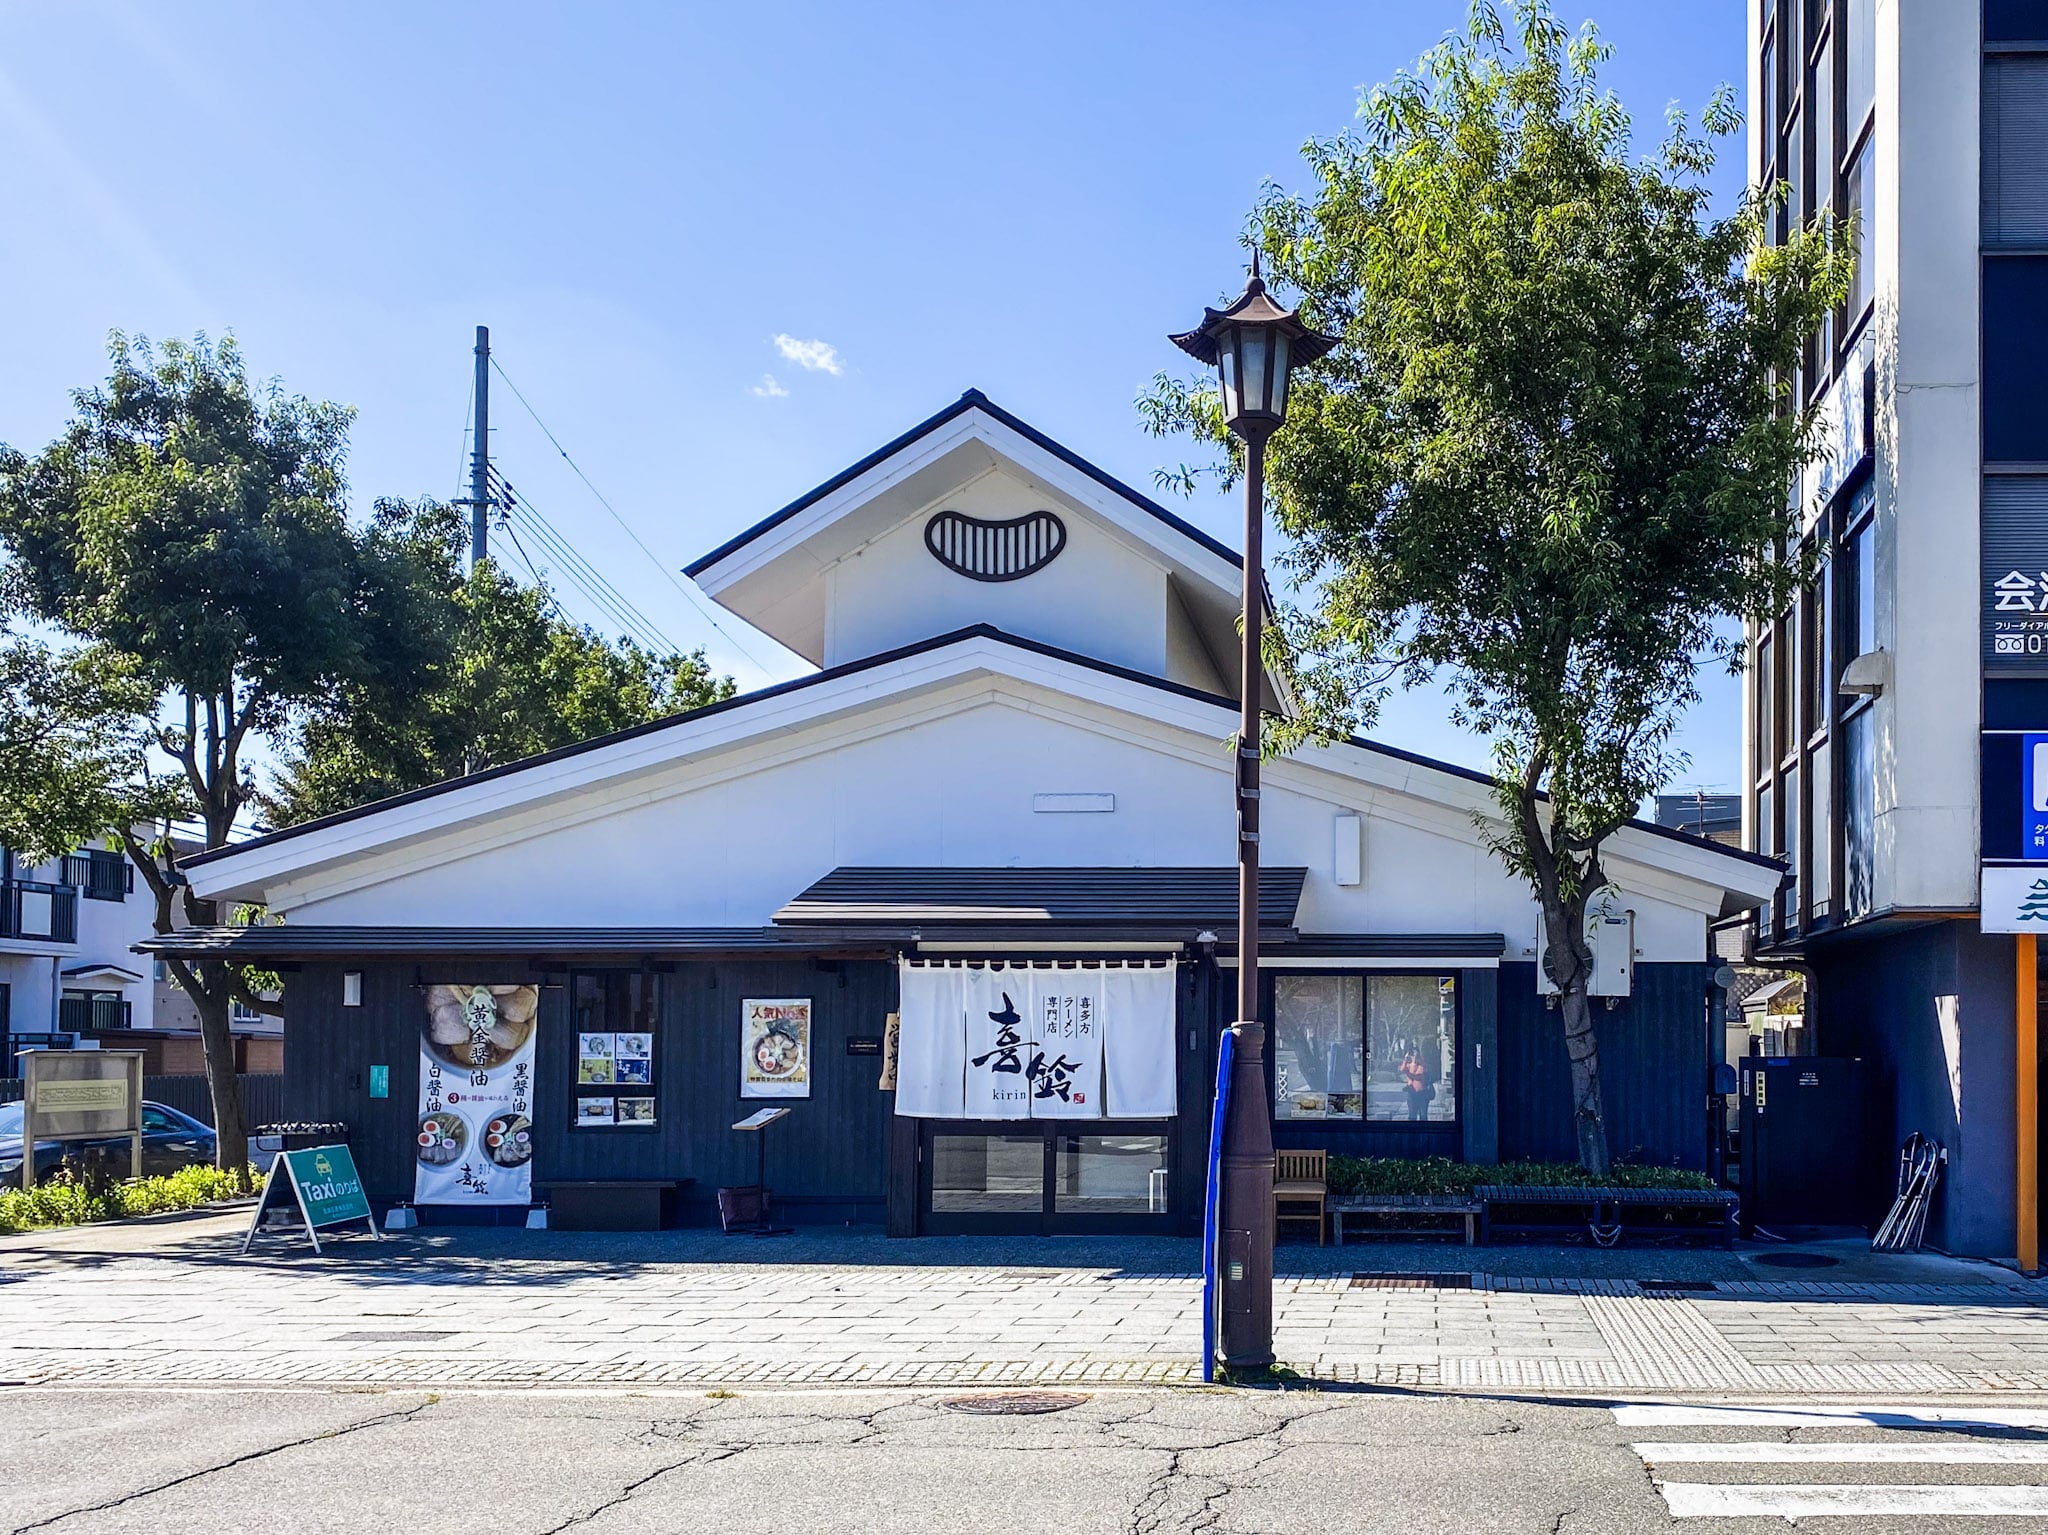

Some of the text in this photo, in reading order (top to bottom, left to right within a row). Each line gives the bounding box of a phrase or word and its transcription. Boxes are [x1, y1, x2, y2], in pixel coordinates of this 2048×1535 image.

[2028, 634, 2048, 653] 0
[1046, 996, 1058, 1034] 専門店
[1064, 996, 1074, 1038] ラーメン
[1080, 996, 1091, 1034] 喜多方
[993, 1089, 1027, 1101] kirin
